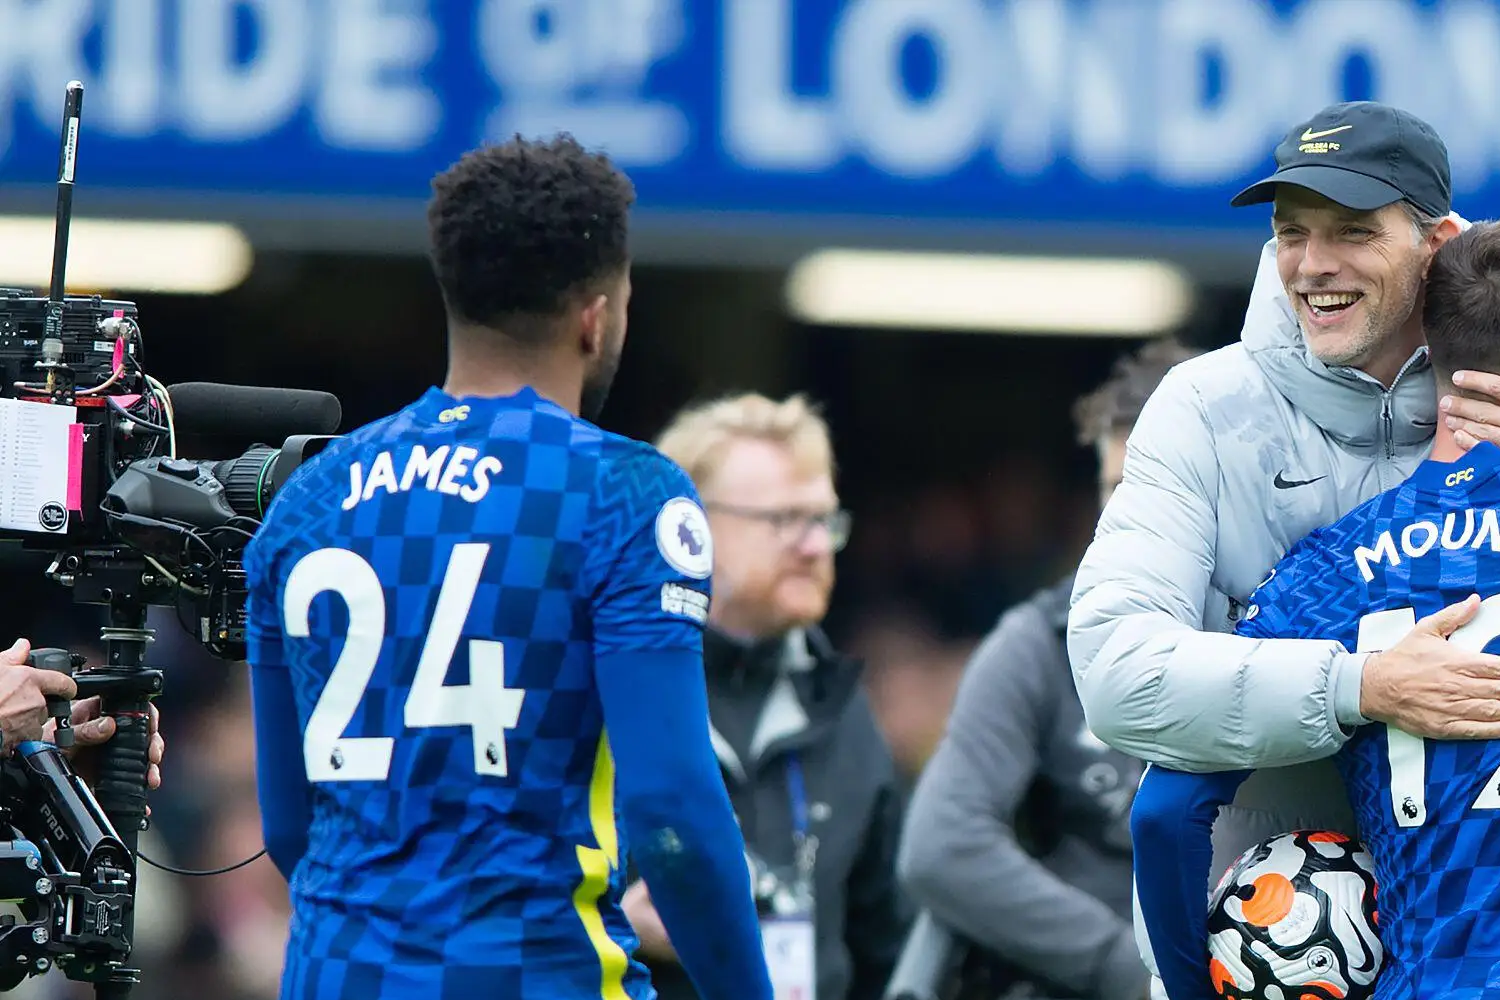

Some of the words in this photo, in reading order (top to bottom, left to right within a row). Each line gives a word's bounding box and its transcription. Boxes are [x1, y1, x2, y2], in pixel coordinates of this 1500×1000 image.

[341, 445, 503, 511] JAMES
[1445, 467, 1475, 487] CFC
[283, 542, 526, 783] 24
